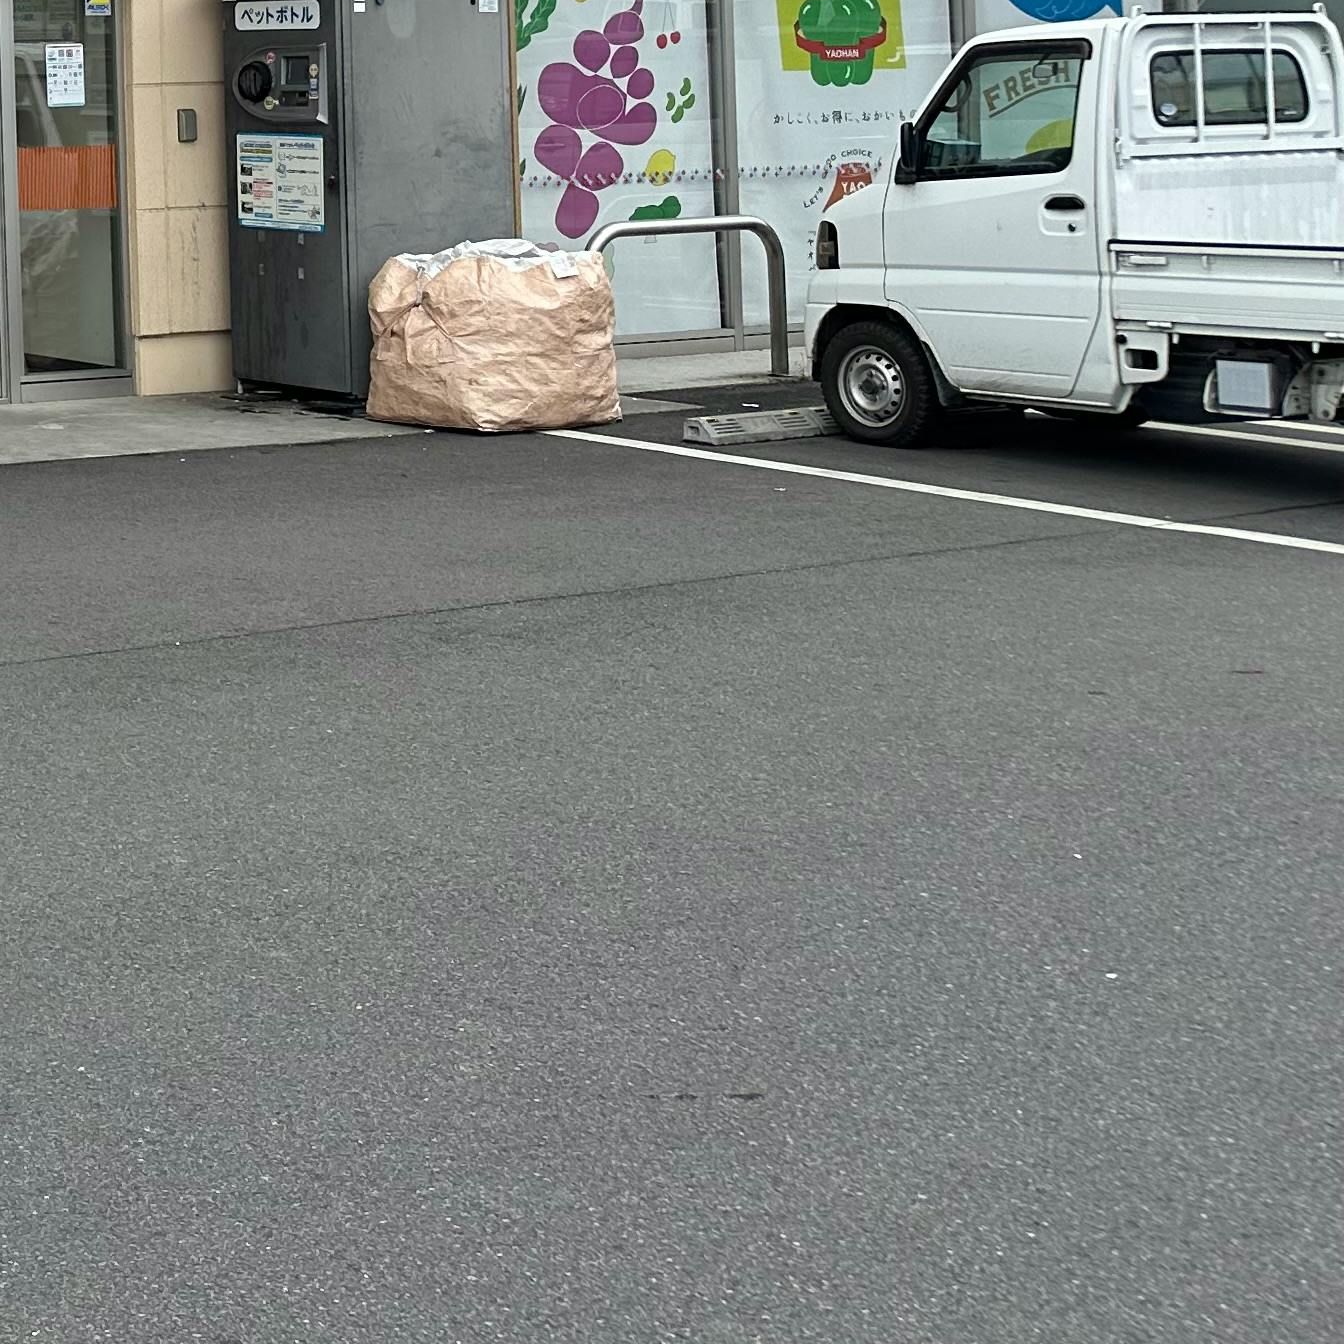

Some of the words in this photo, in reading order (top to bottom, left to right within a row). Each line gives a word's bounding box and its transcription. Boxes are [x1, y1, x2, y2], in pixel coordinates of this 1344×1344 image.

[240, 5, 314, 25] ペットボトル
[824, 49, 860, 59] YAOHAN
[840, 148, 873, 159] CHOICE
